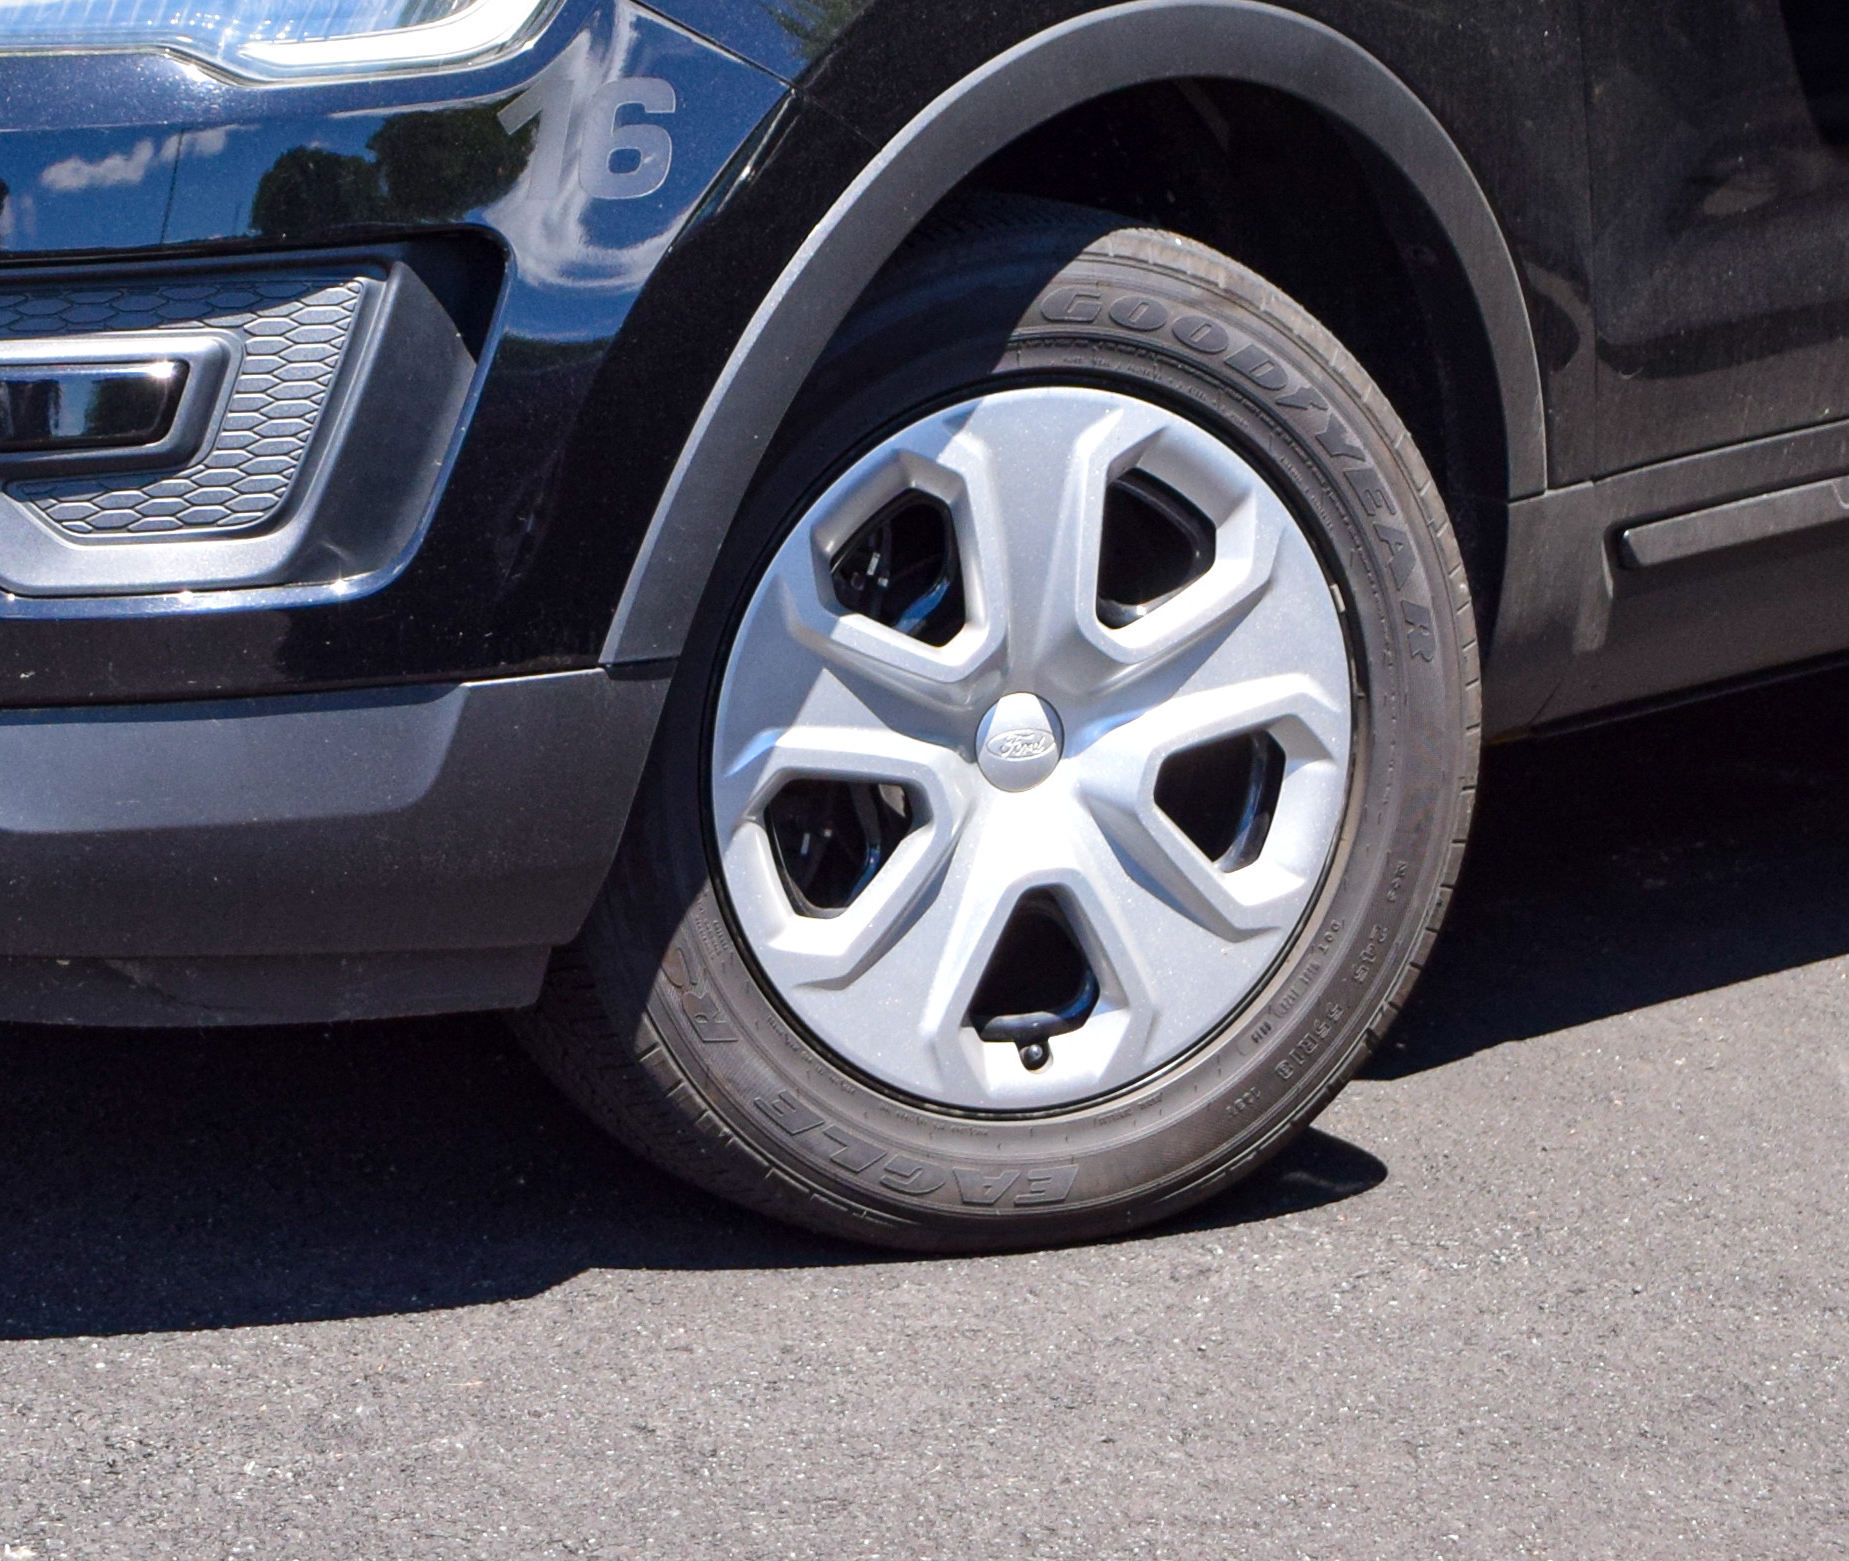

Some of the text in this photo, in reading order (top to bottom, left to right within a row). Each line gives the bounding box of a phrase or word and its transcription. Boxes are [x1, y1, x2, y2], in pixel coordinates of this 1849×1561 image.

[497, 76, 676, 200] 16
[1039, 285, 1437, 664] GOODYEAR
[998, 732, 1047, 758] Ford
[752, 1088, 1080, 1208] EAGLE
